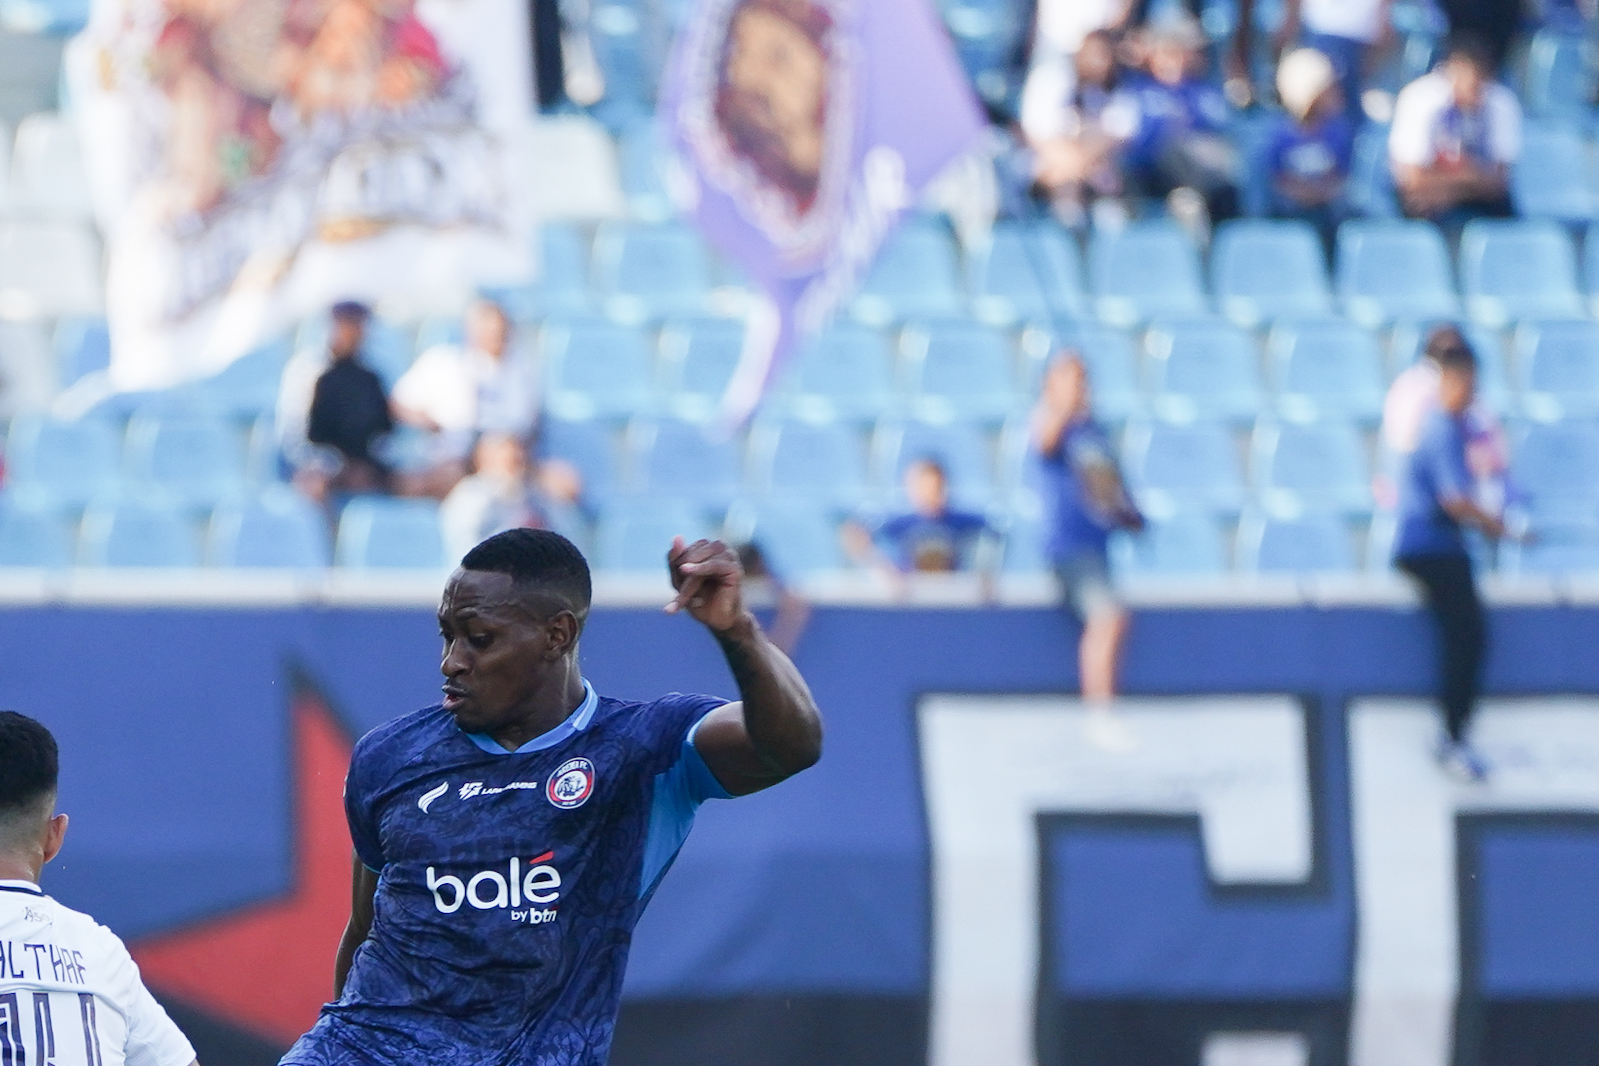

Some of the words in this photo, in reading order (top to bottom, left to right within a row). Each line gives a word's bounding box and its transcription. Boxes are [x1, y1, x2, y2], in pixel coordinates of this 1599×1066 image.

[426, 850, 562, 914] balé
[511, 910, 528, 922] by
[529, 907, 557, 924] btn
